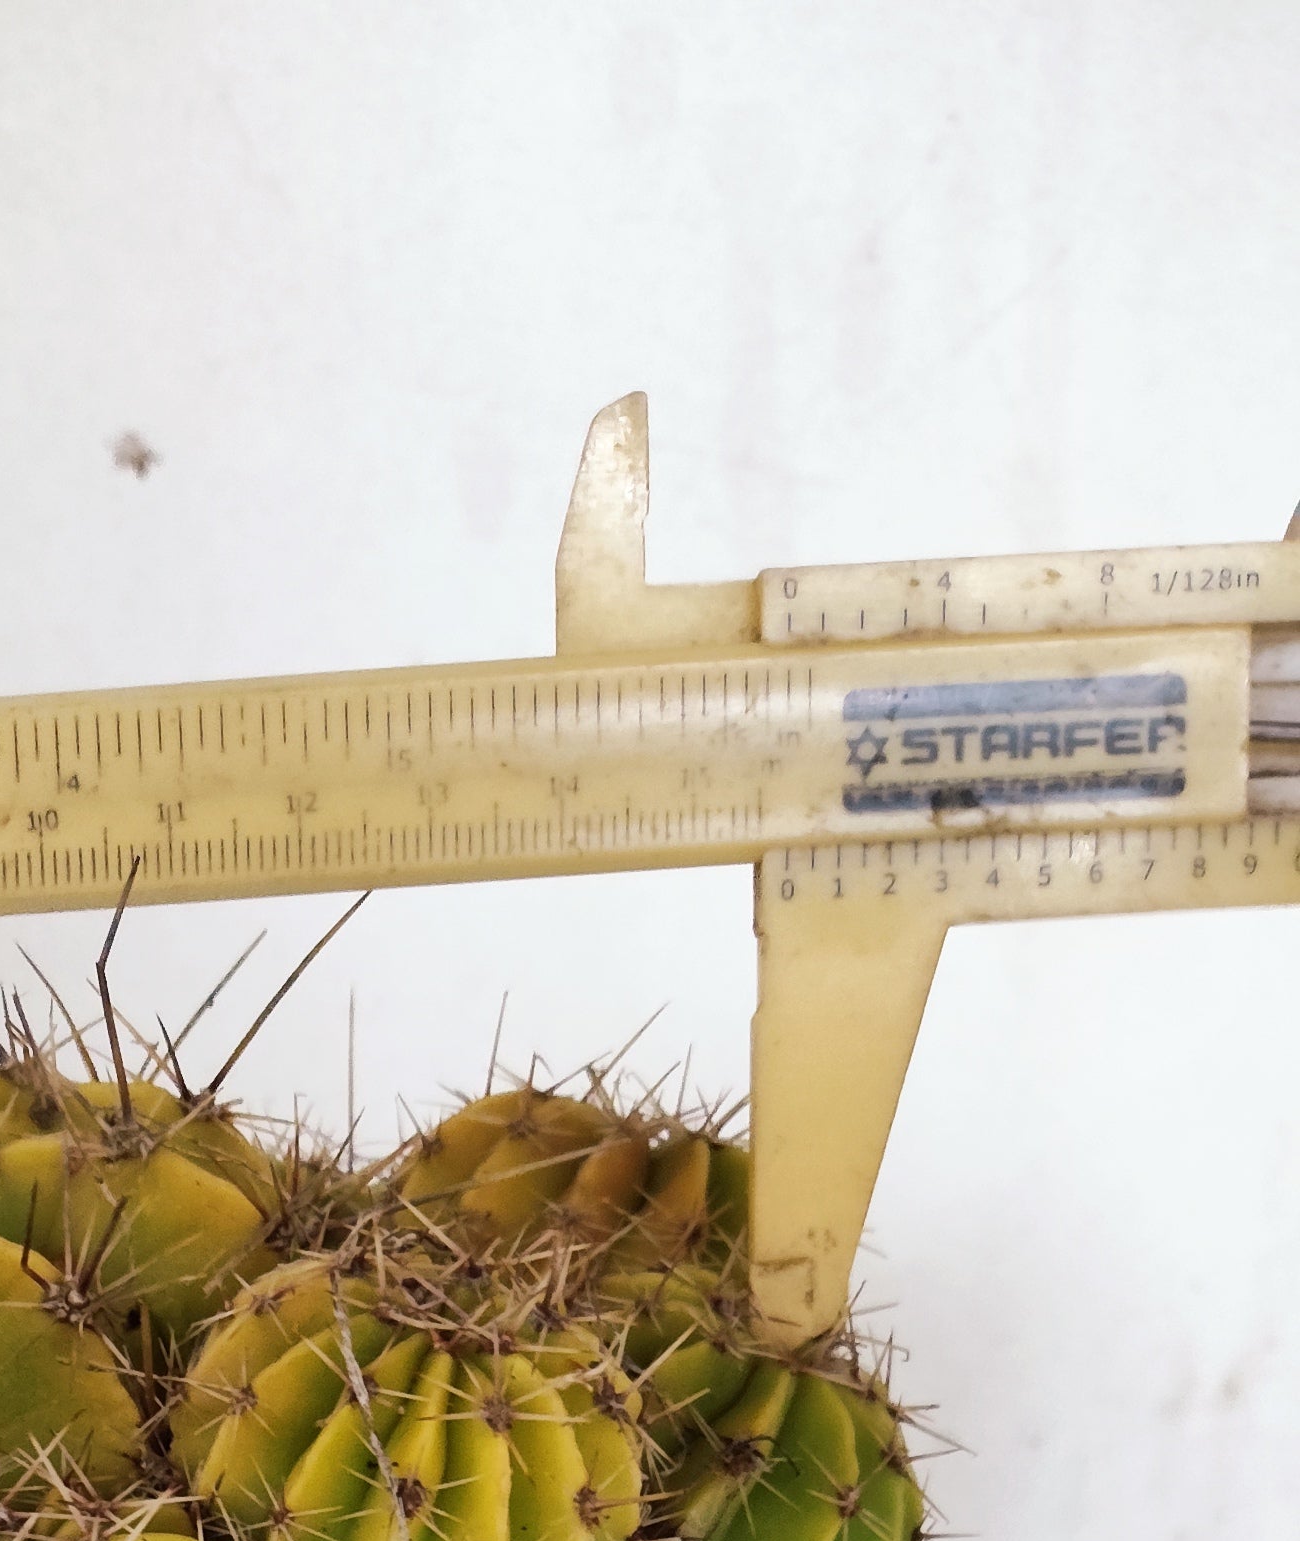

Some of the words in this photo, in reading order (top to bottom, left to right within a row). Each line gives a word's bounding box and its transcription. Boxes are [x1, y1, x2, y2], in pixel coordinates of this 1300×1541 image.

[783, 577, 798, 600] 0
[937, 571, 951, 592] 4
[1100, 563, 1114, 586] 8
[1151, 568, 1260, 597] 1/128in
[66, 773, 81, 793] 4
[26, 808, 60, 832] 10
[156, 801, 187, 823] 11
[286, 792, 318, 814] 12
[781, 878, 795, 901] 0
[833, 877, 844, 898] 1
[883, 872, 896, 895] 2
[935, 870, 948, 893] 3
[985, 867, 1000, 888] 4
[1038, 863, 1051, 887] 5
[1089, 861, 1103, 884] 6
[1142, 858, 1155, 881] 7
[1192, 855, 1206, 879] 8
[1243, 853, 1258, 875] 9
